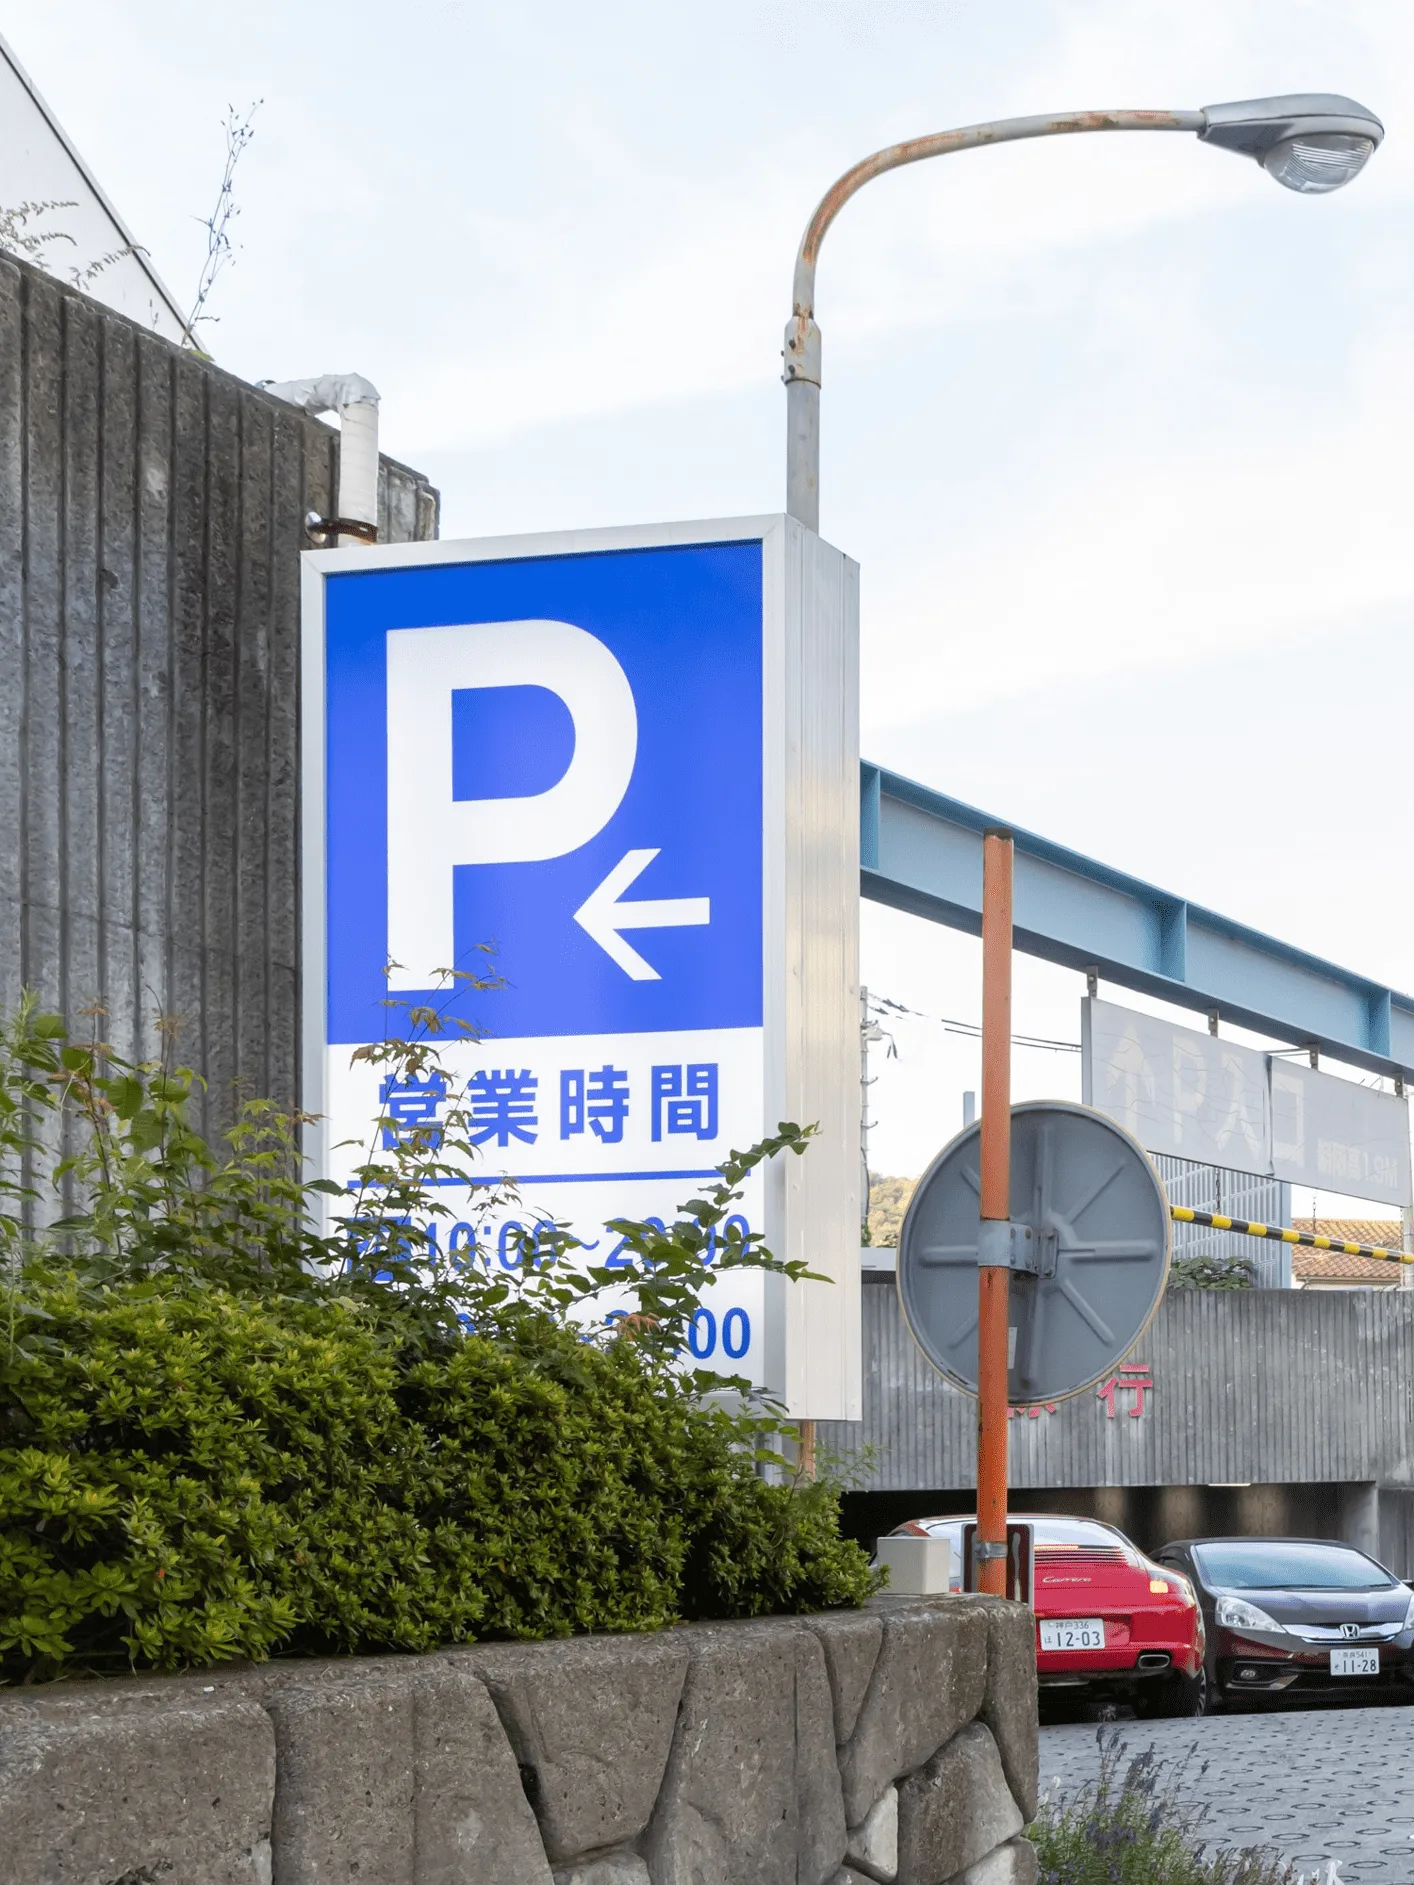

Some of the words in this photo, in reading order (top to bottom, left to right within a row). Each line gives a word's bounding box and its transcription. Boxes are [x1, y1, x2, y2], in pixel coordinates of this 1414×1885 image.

[387, 619, 638, 992] P
[379, 1063, 719, 1151] 営業時間
[1057, 1631, 1101, 1647] 12-03
[1343, 1659, 1377, 1673] 11-28
